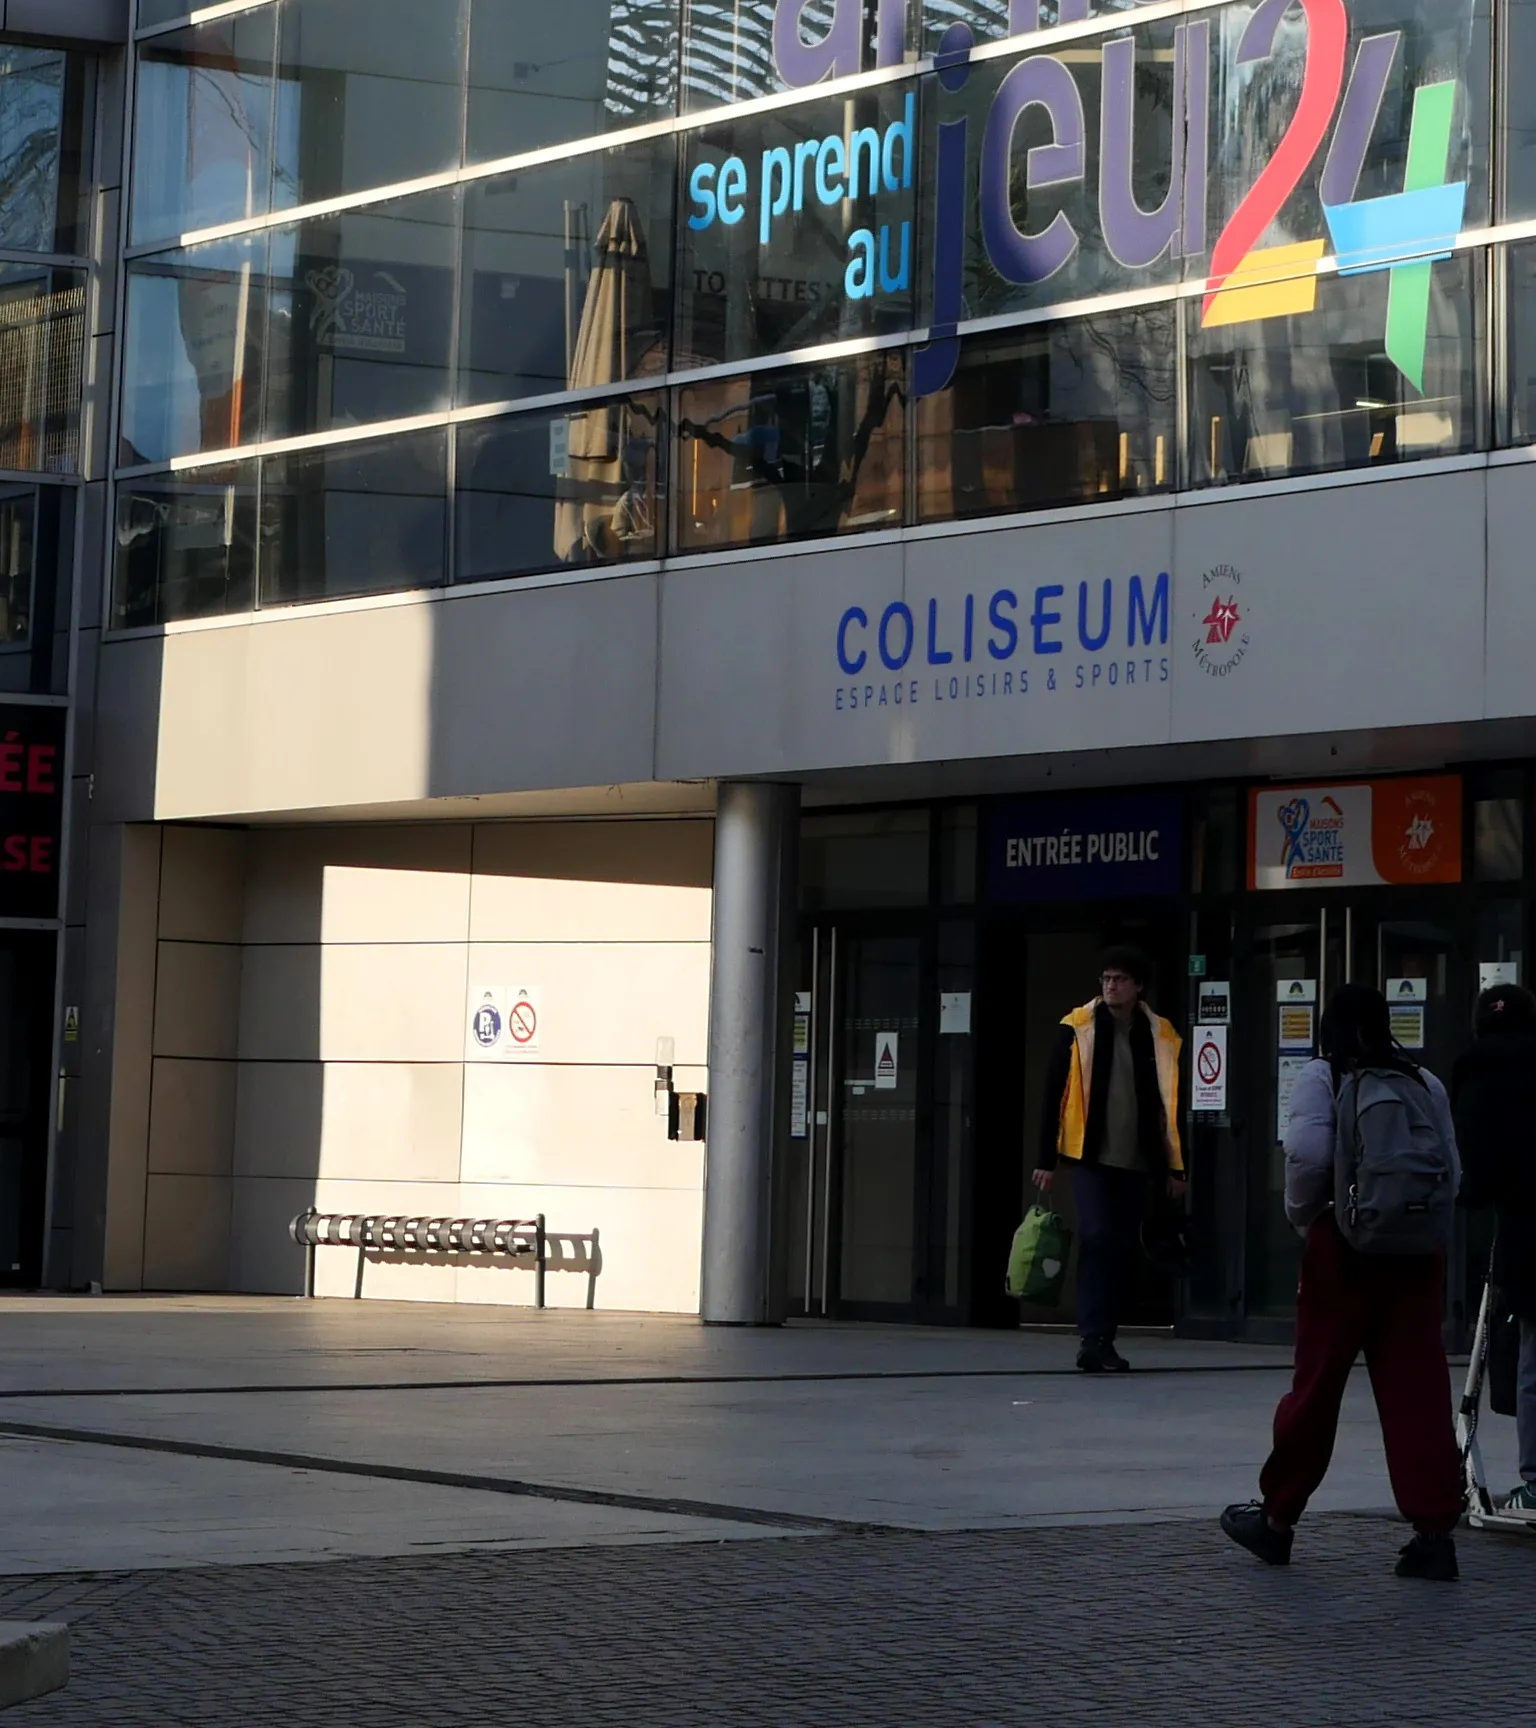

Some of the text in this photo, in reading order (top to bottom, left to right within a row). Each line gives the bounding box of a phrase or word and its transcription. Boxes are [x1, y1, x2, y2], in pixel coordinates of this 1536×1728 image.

[689, 92, 915, 244] se prend
[845, 220, 910, 300] au
[351, 315, 406, 338] SANTÉ
[1202, 564, 1240, 589] AMIENS
[837, 572, 1168, 674] COLISEUM
[1192, 633, 1251, 677] MÉTROPOLE
[836, 658, 1168, 711] ESPACE LOISIRS & SPORTS
[1006, 828, 1159, 867] ENTRÉE PUBLIC
[1303, 830, 1338, 847] SPORT
